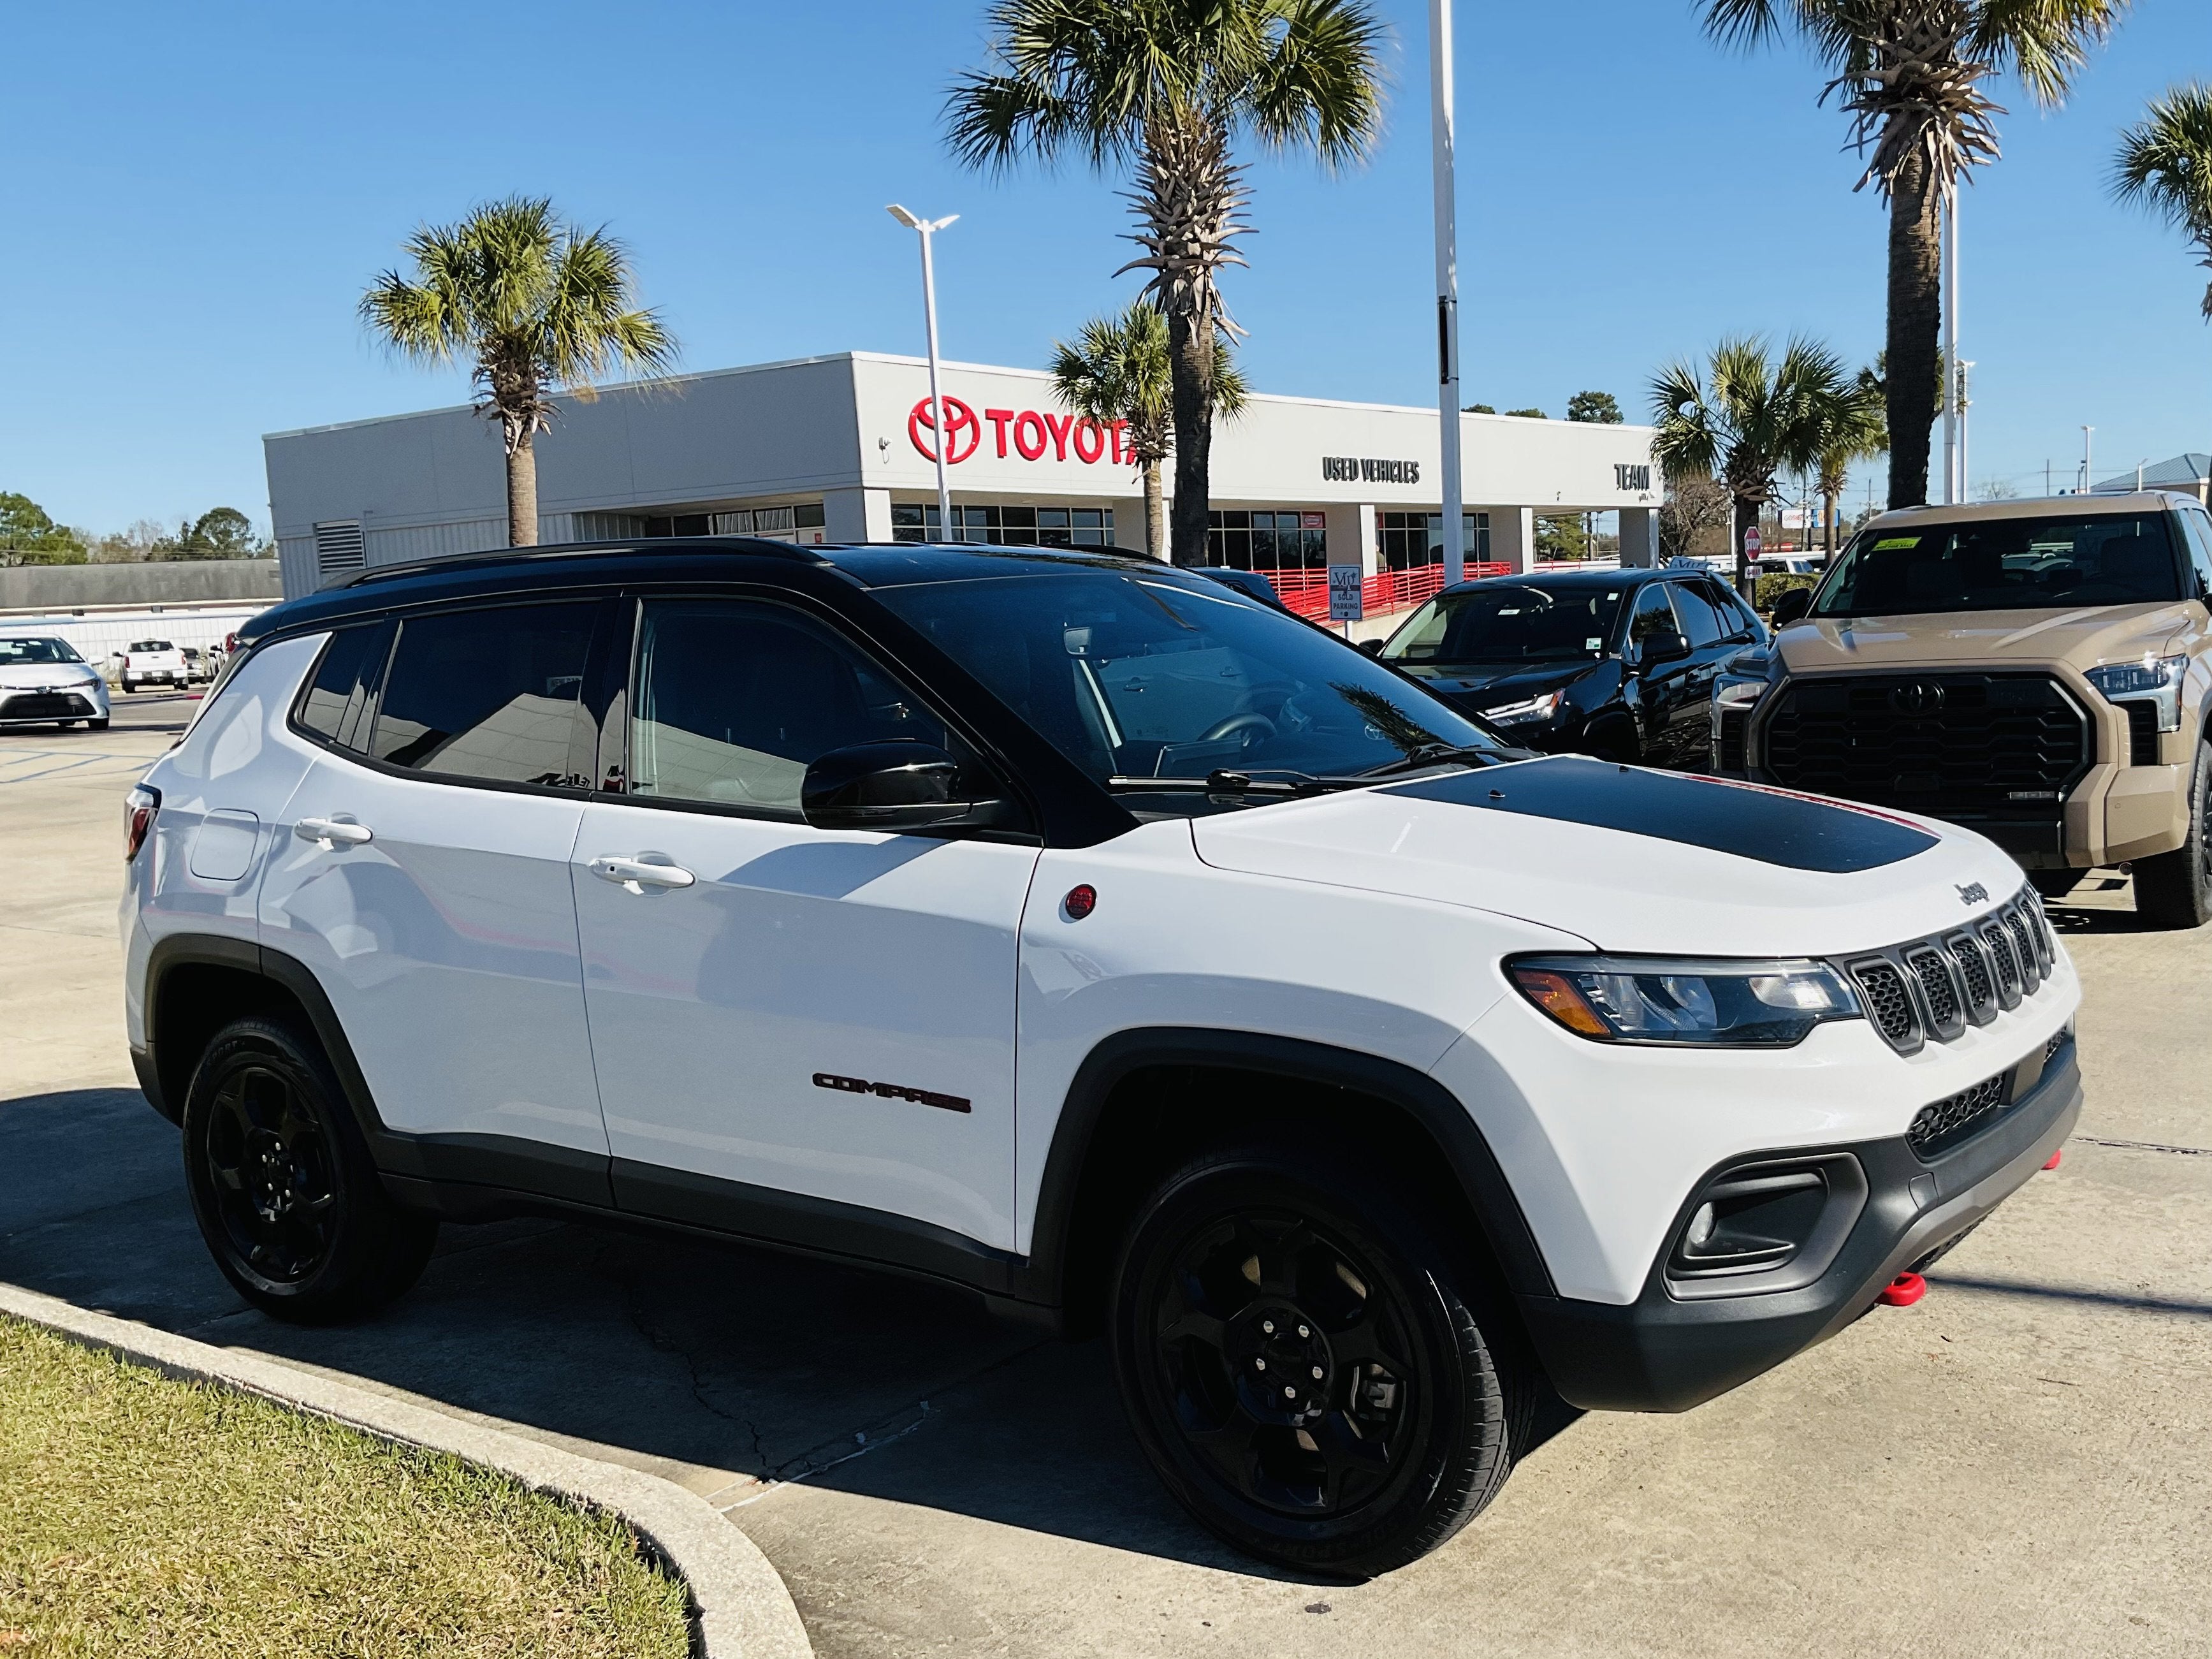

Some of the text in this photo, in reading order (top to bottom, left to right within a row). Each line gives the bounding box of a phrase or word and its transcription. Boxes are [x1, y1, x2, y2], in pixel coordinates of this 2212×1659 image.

[985, 408, 1137, 465] TOYOT
[1322, 457, 1420, 485] USED VEHICLES
[1613, 464, 1650, 490] TEAM
[1746, 538, 1760, 550] STOP
[1337, 593, 1353, 601] SOLD
[812, 1072, 971, 1114] COMPASS
